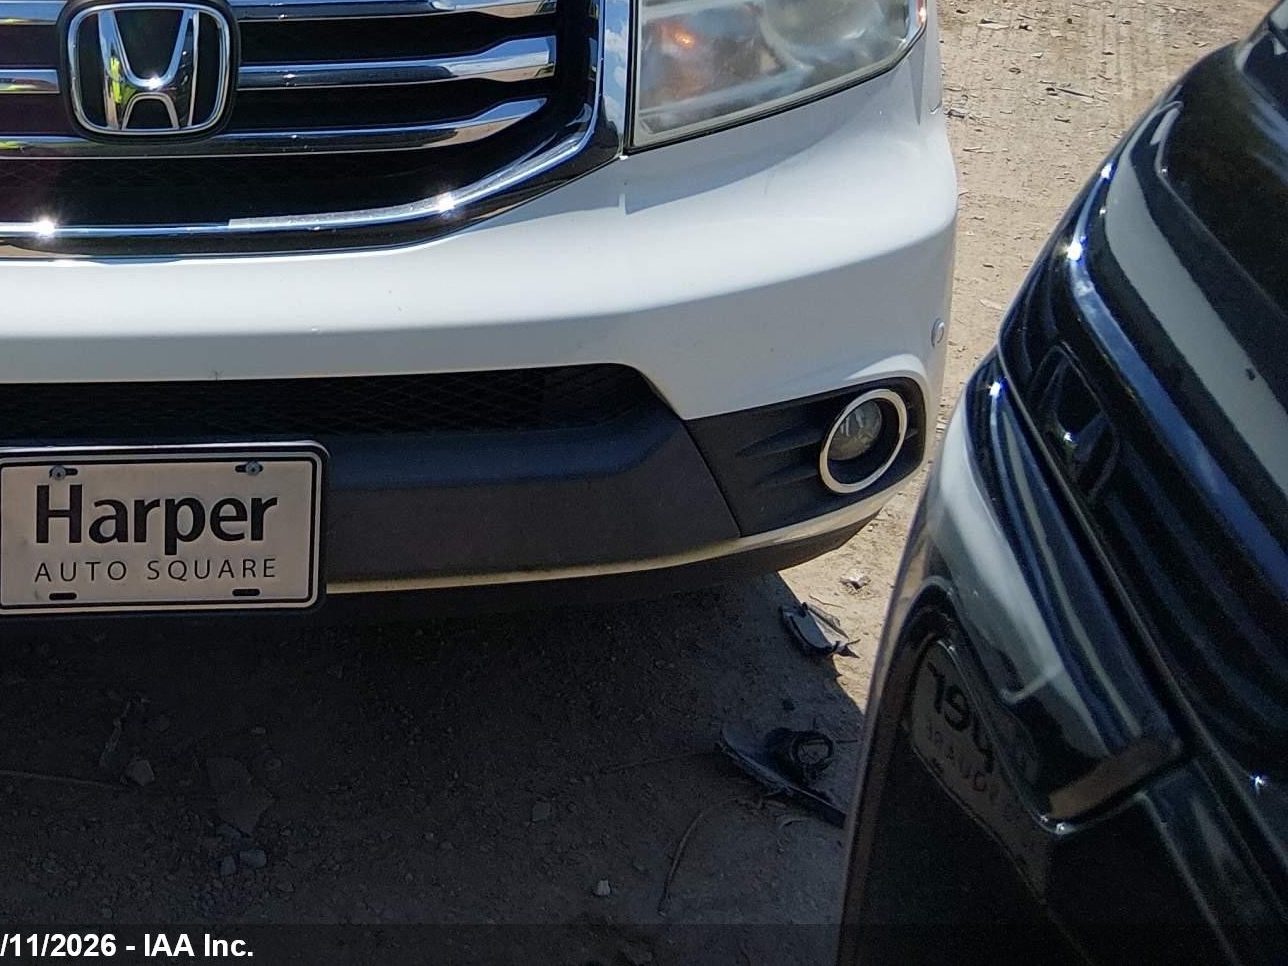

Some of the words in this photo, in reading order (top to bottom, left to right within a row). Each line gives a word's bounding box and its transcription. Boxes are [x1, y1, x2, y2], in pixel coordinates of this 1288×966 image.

[35, 483, 279, 556] Harper
[34, 560, 127, 583] AUTO
[147, 558, 277, 582] SQUARE
